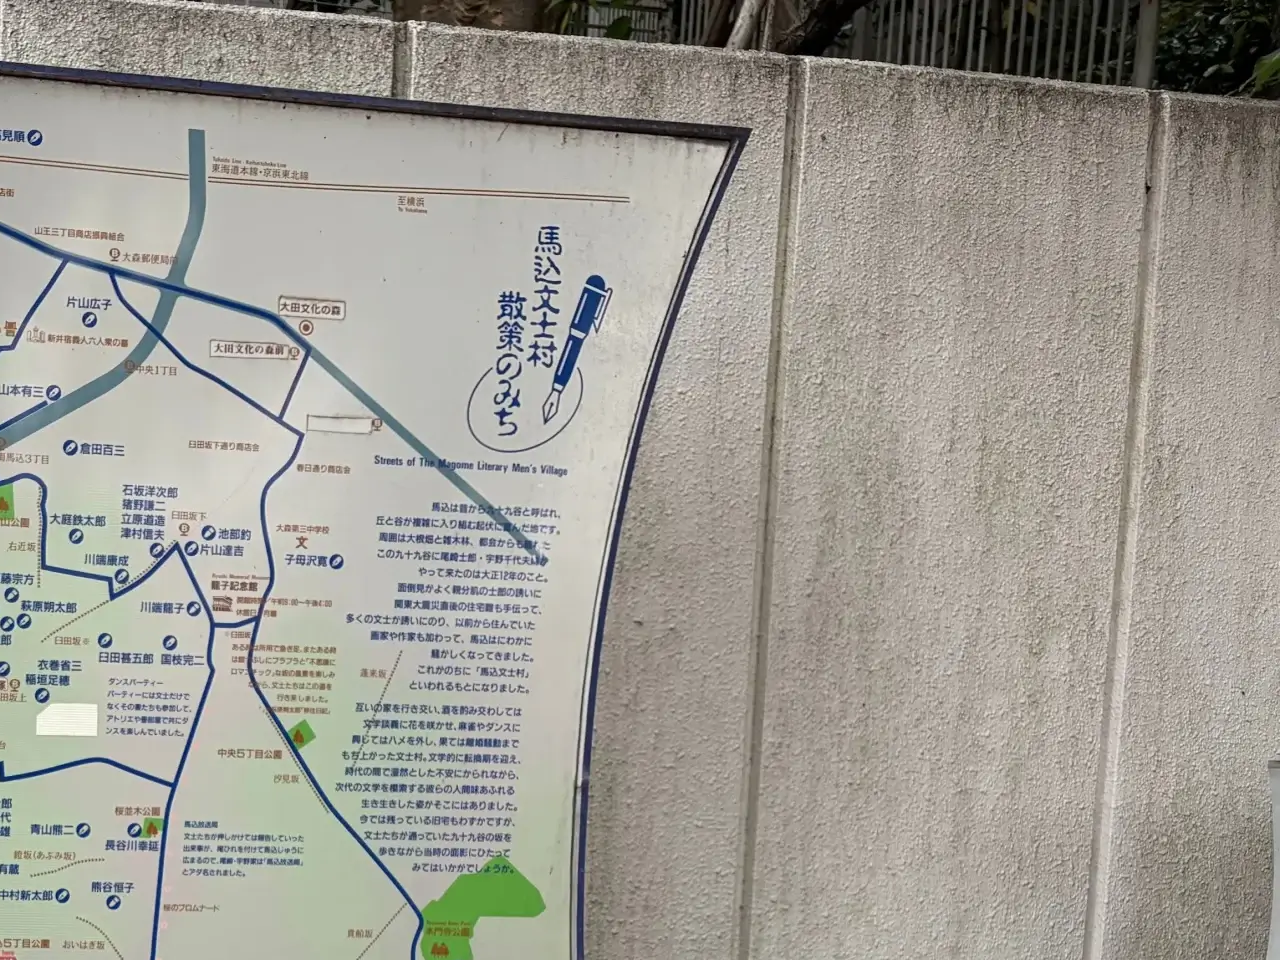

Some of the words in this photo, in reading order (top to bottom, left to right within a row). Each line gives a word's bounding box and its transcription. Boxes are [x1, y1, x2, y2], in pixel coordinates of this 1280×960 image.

[67, 297, 112, 310] 片山広子
[528, 226, 562, 368] 馬込文士村
[280, 301, 341, 315] 大田文化の森
[214, 344, 284, 356] 大田文化の森前
[494, 291, 527, 436] 散策のみち
[136, 365, 177, 376] 中央1丁目
[80, 443, 125, 456] 倉田百三
[374, 456, 403, 466] Streets
[407, 458, 416, 466] of
[420, 458, 435, 468] The
[438, 459, 474, 470] Magome
[478, 461, 508, 473] Literary
[512, 462, 537, 474] Men's
[540, 463, 568, 476] Village
[122, 485, 178, 498] 石坂洋次郎
[49, 514, 106, 527] 大庭鉄太郎
[121, 513, 165, 526] 立原道造
[121, 528, 164, 540] 津村信夫
[200, 544, 243, 557] 片山達吉
[84, 553, 129, 566] 川端康成
[285, 554, 328, 567] 子母沢寛
[211, 580, 258, 591] 龍子記念館
[21, 601, 77, 614] 萩原朔太郎
[140, 601, 184, 614] 川端龍子
[38, 659, 82, 672] 衣巻省三
[161, 654, 204, 666] 国枝完二
[26, 674, 70, 687] 稲垣足穂
[218, 749, 282, 759] 中央5丁目公園
[115, 806, 160, 817] 桜並木公園
[30, 824, 73, 836] 青山熊二
[105, 840, 159, 852] 長谷川幸延
[91, 882, 134, 893] 熊谷恒子
